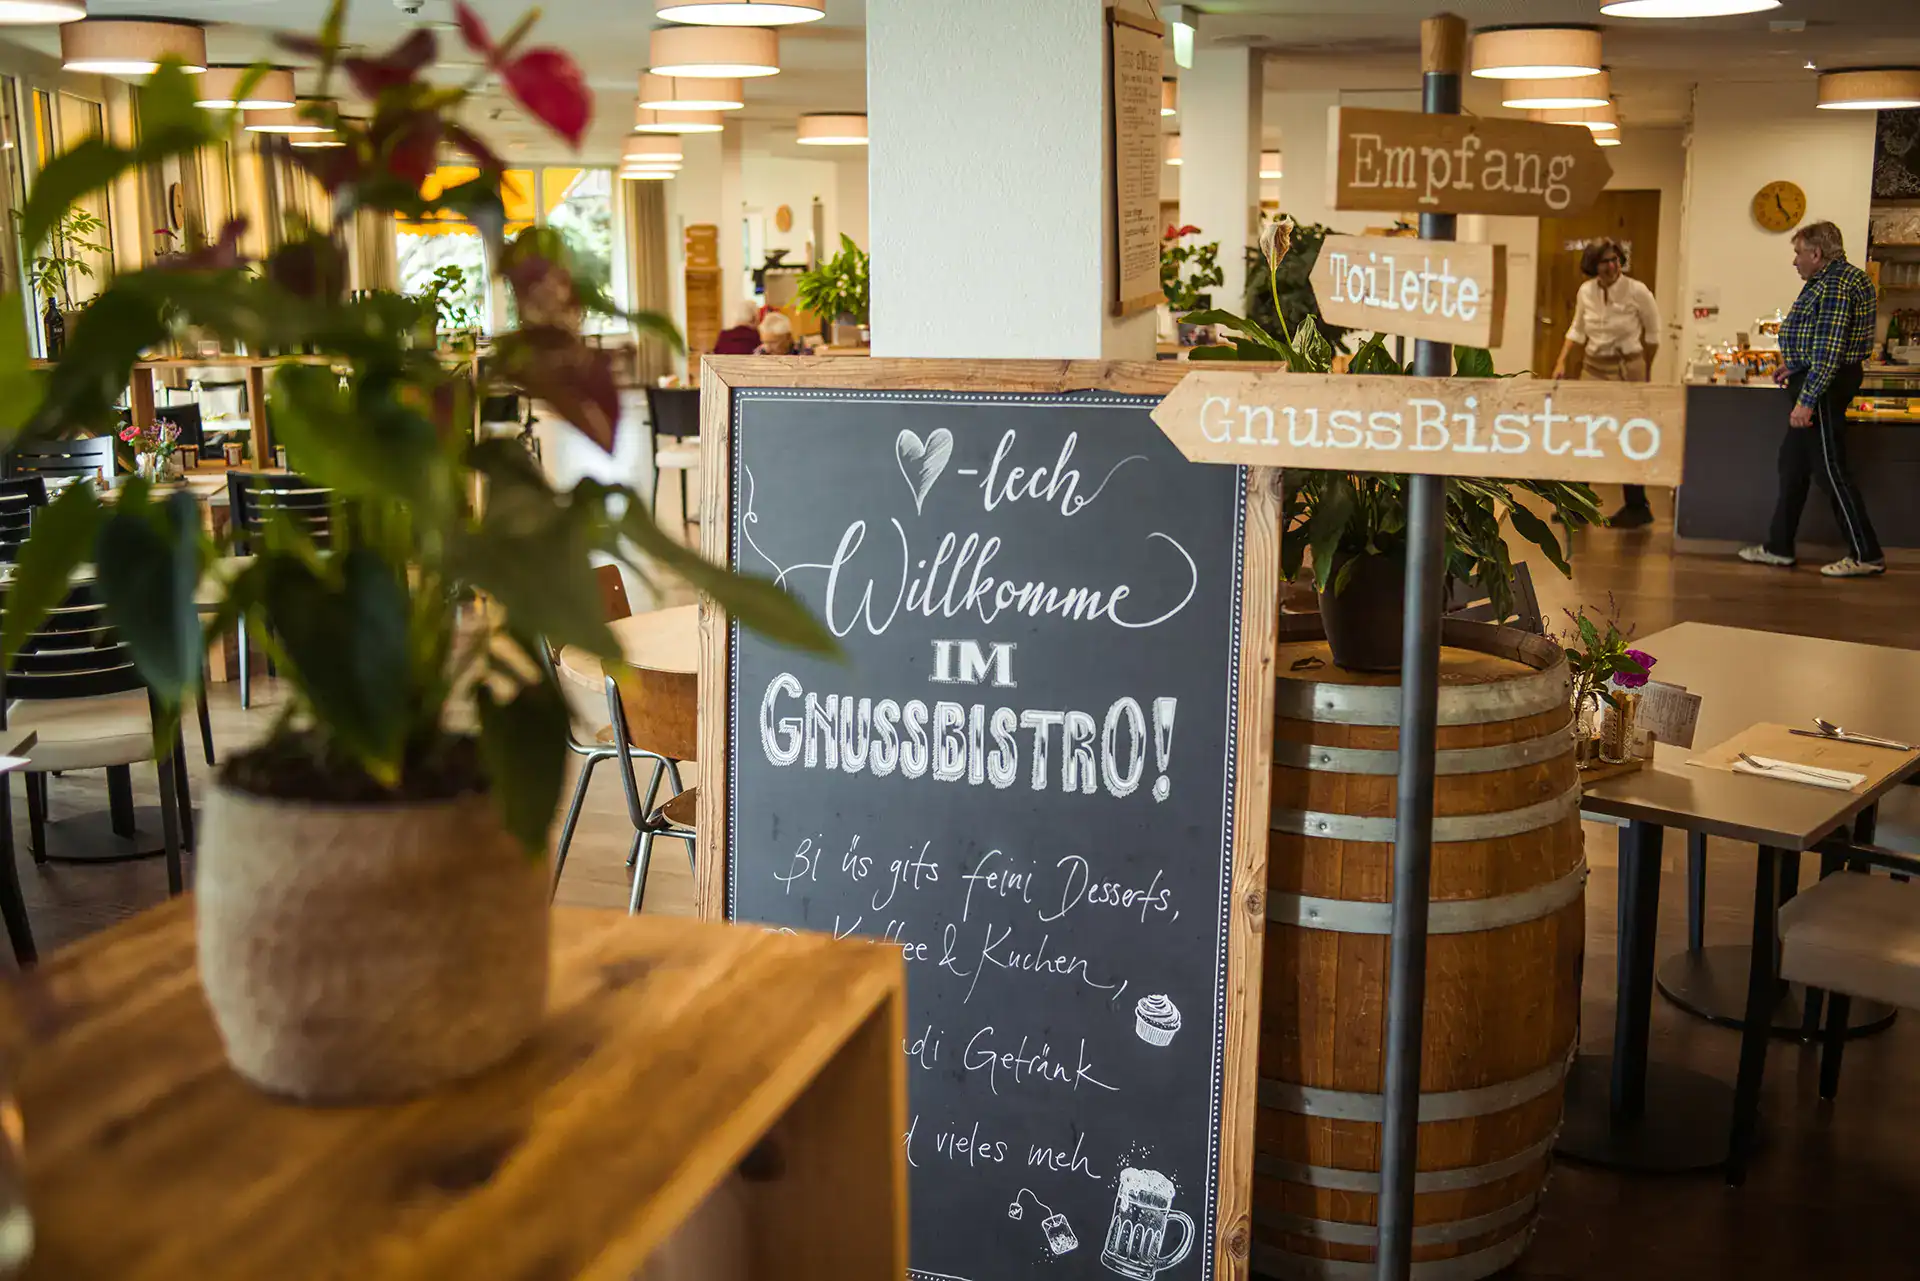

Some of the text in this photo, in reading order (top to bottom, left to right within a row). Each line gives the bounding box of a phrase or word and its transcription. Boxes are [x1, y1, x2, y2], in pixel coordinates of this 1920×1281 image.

[1348, 132, 1575, 210] Empfang
[1329, 251, 1480, 322] Toilette
[1199, 394, 1661, 461] GnussBistro
[773, 517, 1198, 638] Willkomme
[928, 638, 1018, 688] IM
[773, 833, 1181, 923] Bi üs gits feini Desserts,
[938, 923, 972, 977] &
[963, 923, 1128, 1005] Kuchen,
[963, 1026, 1121, 1096] Getränk
[936, 1121, 1008, 1168] vieles
[1027, 1131, 1102, 1179] meh
